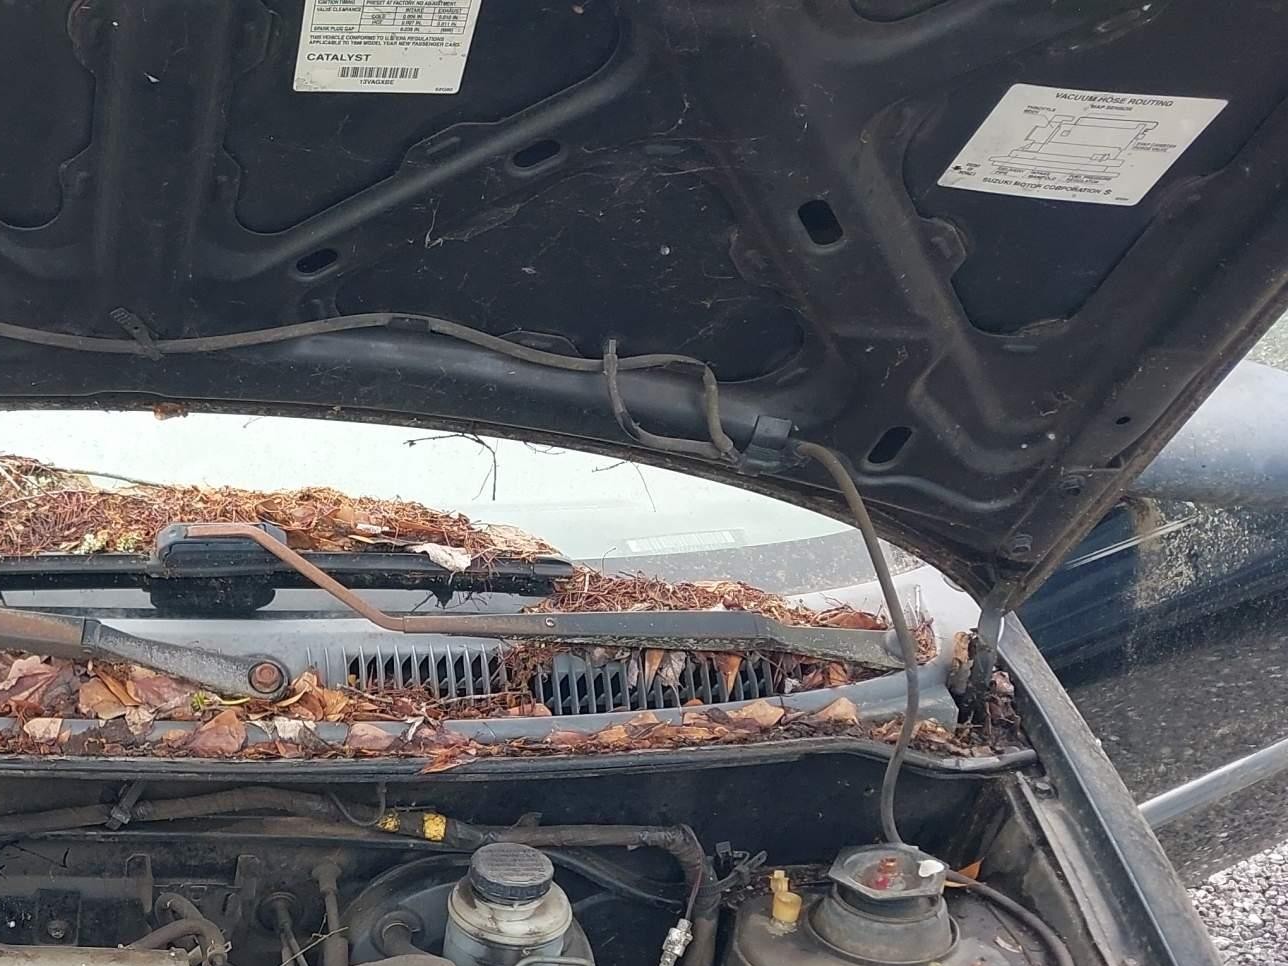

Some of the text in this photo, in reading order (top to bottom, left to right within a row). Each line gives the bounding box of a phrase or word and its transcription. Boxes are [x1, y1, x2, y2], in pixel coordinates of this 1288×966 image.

[307, 53, 371, 62] CATALYST
[1055, 92, 1173, 107] VACUUM HOSE ROUTING
[982, 177, 1013, 186] SUZUKI
[1013, 181, 1042, 189] MOTOR
[1043, 184, 1102, 194] CORPORATION
